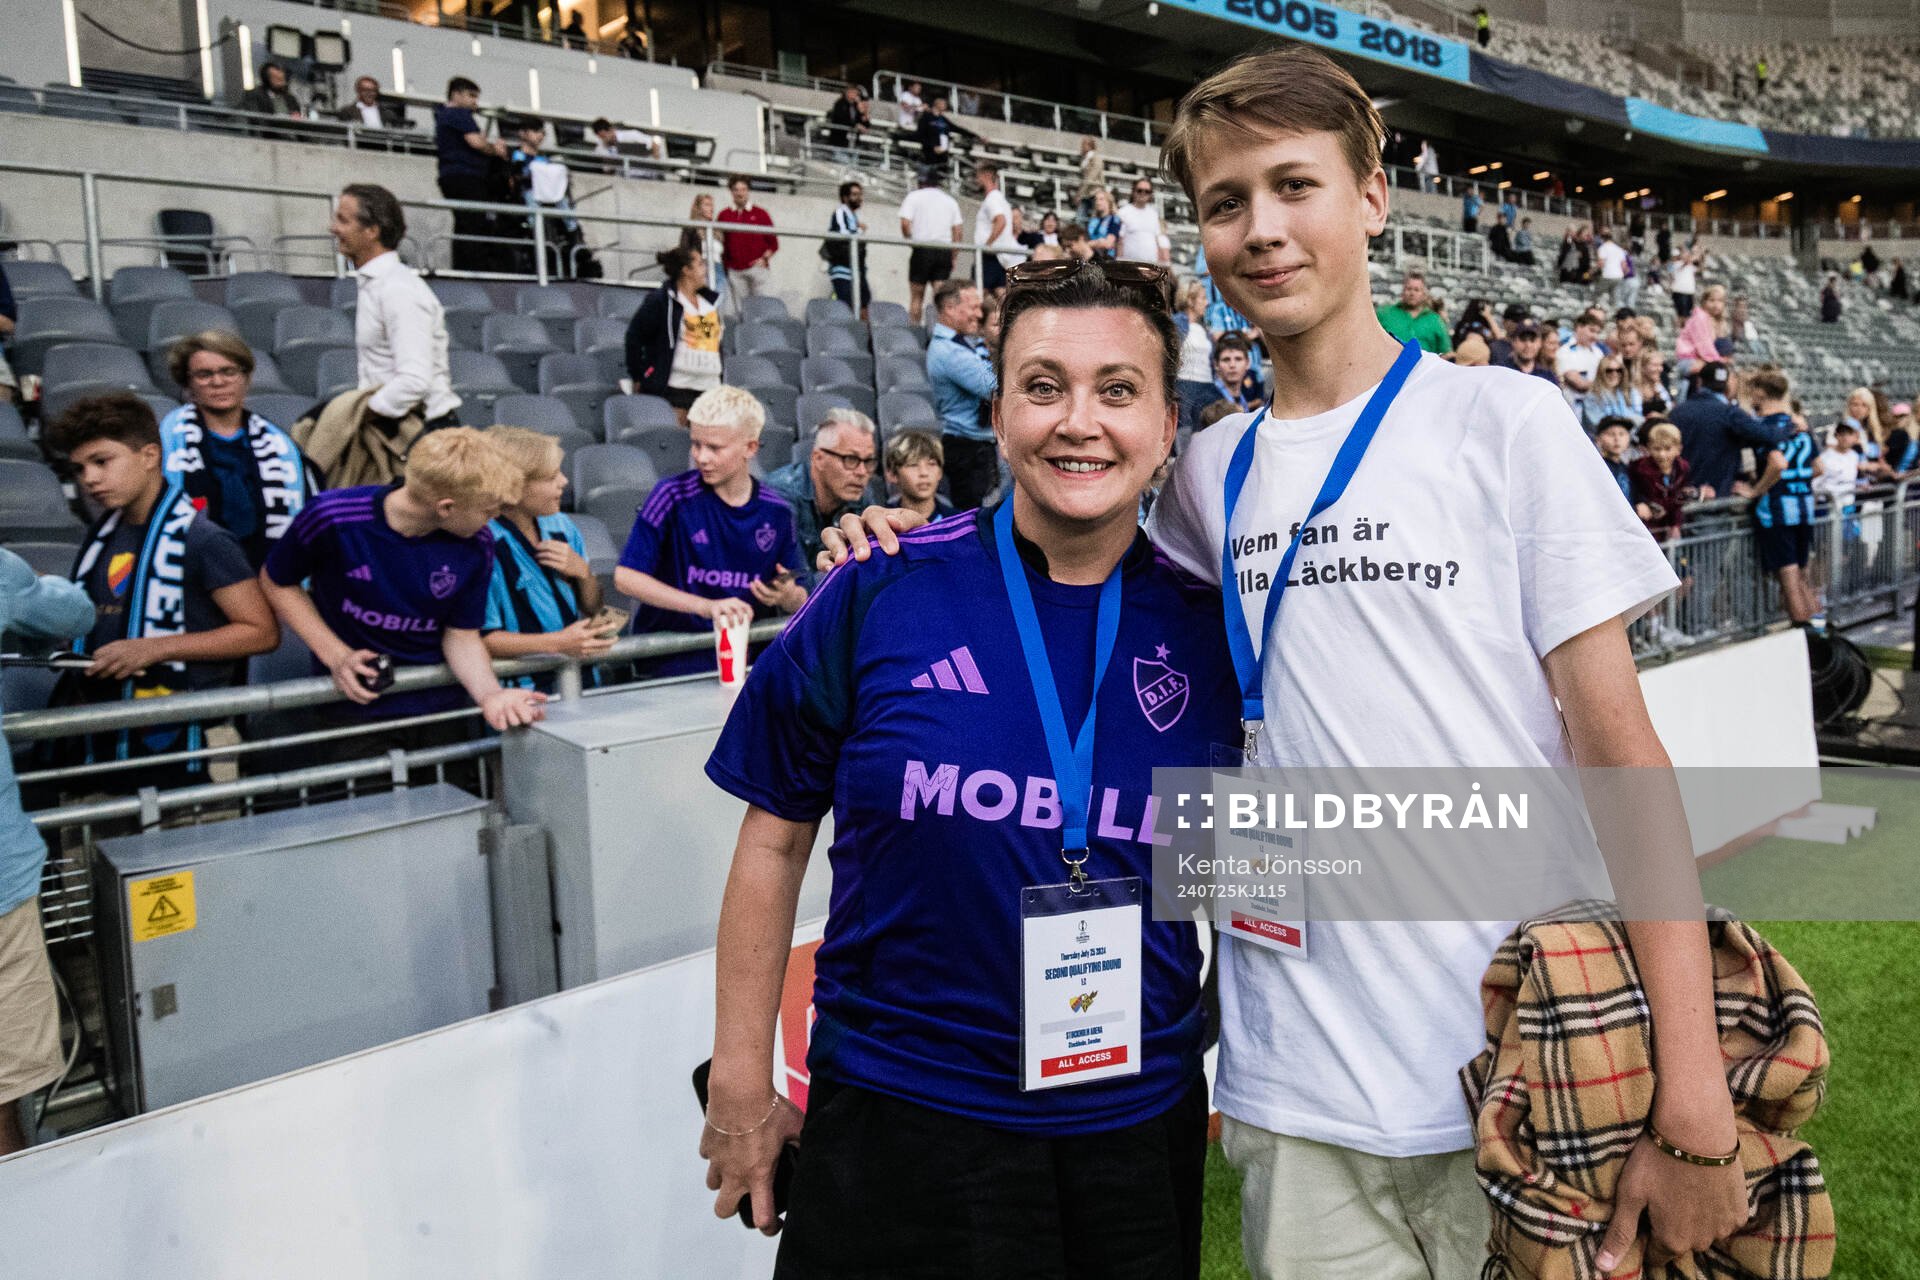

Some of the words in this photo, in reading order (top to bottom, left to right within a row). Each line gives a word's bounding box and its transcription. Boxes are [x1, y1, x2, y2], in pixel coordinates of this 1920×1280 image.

[1359, 21, 1444, 68] 2018
[1232, 531, 1278, 560] Vem
[1289, 522, 1339, 546] fan
[1353, 517, 1390, 541] är
[1234, 568, 1270, 595] lla
[342, 598, 438, 632] MOBILL
[900, 760, 1174, 847] MOBLL
[1244, 917, 1257, 928] ALL
[1260, 921, 1287, 937] ACCESS
[1045, 966, 1068, 980] SECOND
[1069, 961, 1101, 978] QUALIFYING
[1058, 1058, 1074, 1068] ALL
[1078, 1052, 1112, 1065] ACCESS
